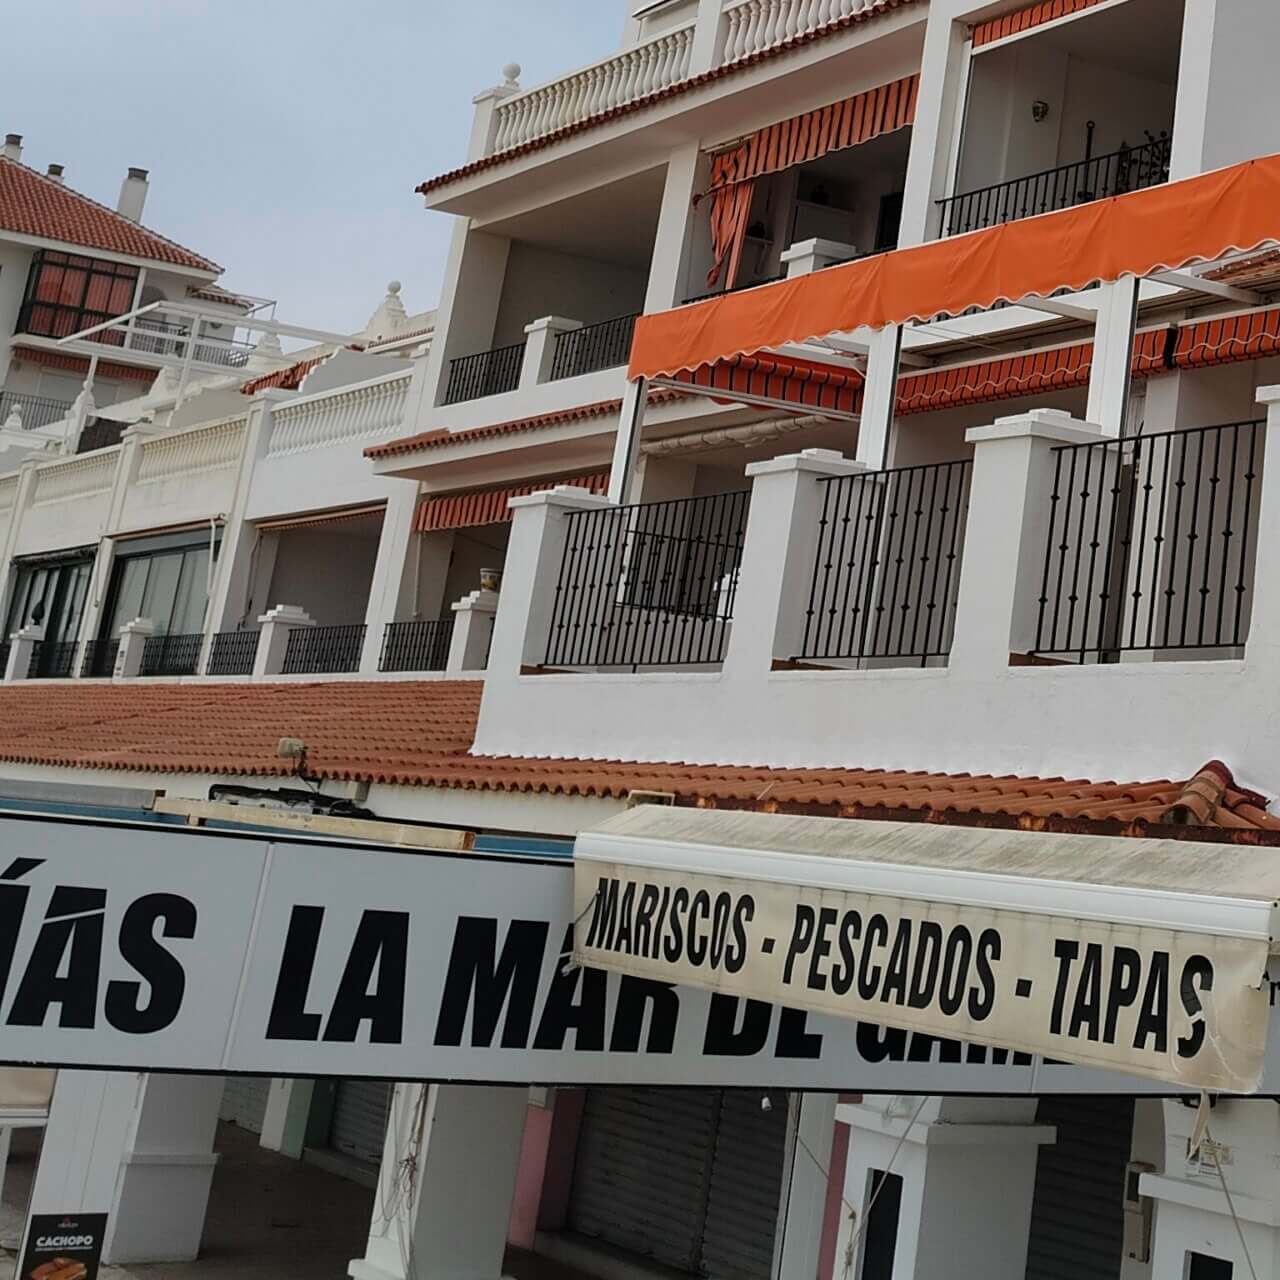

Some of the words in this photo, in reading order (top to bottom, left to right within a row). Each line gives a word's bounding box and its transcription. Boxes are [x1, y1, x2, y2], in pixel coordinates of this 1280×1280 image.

[265, 904, 410, 1045] LA
[585, 877, 755, 974] MARISCOS
[783, 903, 1002, 1022] PESCADOS
[1049, 938, 1214, 1059] TAPAS
[36, 1235, 93, 1247] CACHOPO
